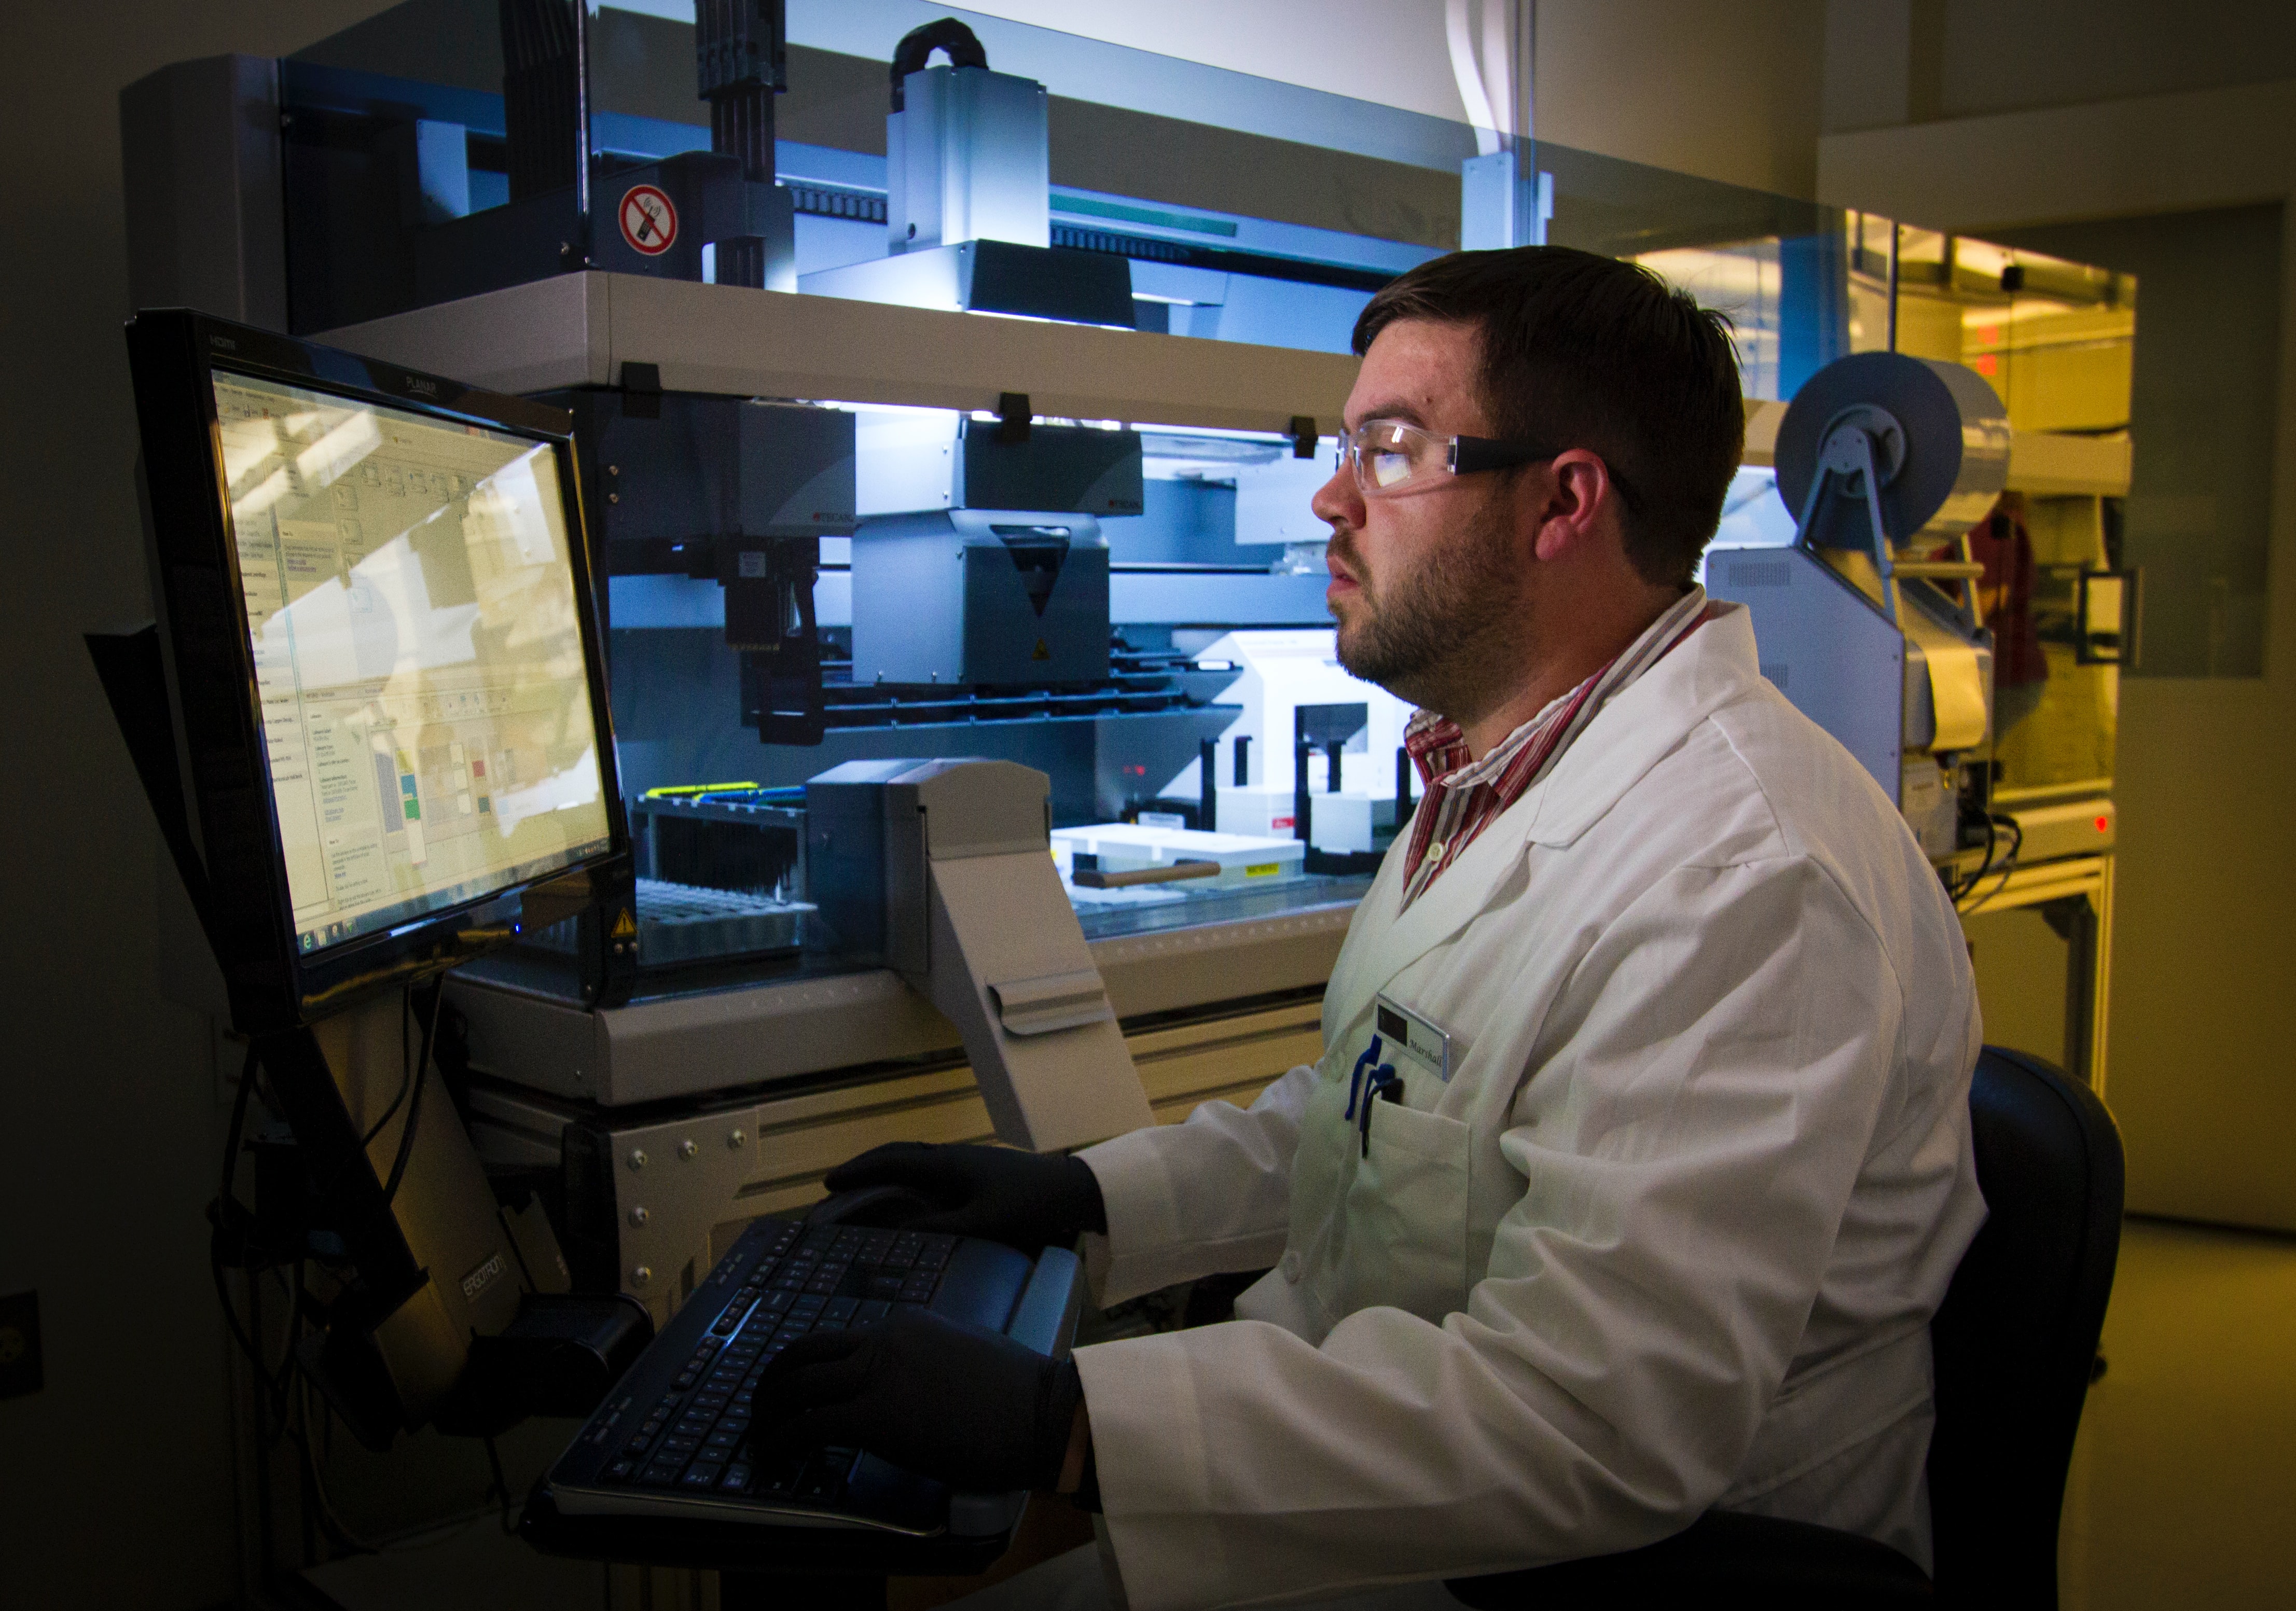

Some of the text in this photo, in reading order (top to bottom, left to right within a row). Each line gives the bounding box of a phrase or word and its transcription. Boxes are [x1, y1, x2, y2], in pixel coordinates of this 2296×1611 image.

[209, 334, 235, 350] HDMI
[406, 377, 436, 393] PLANAR
[1409, 1039, 1442, 1067] Marshall
